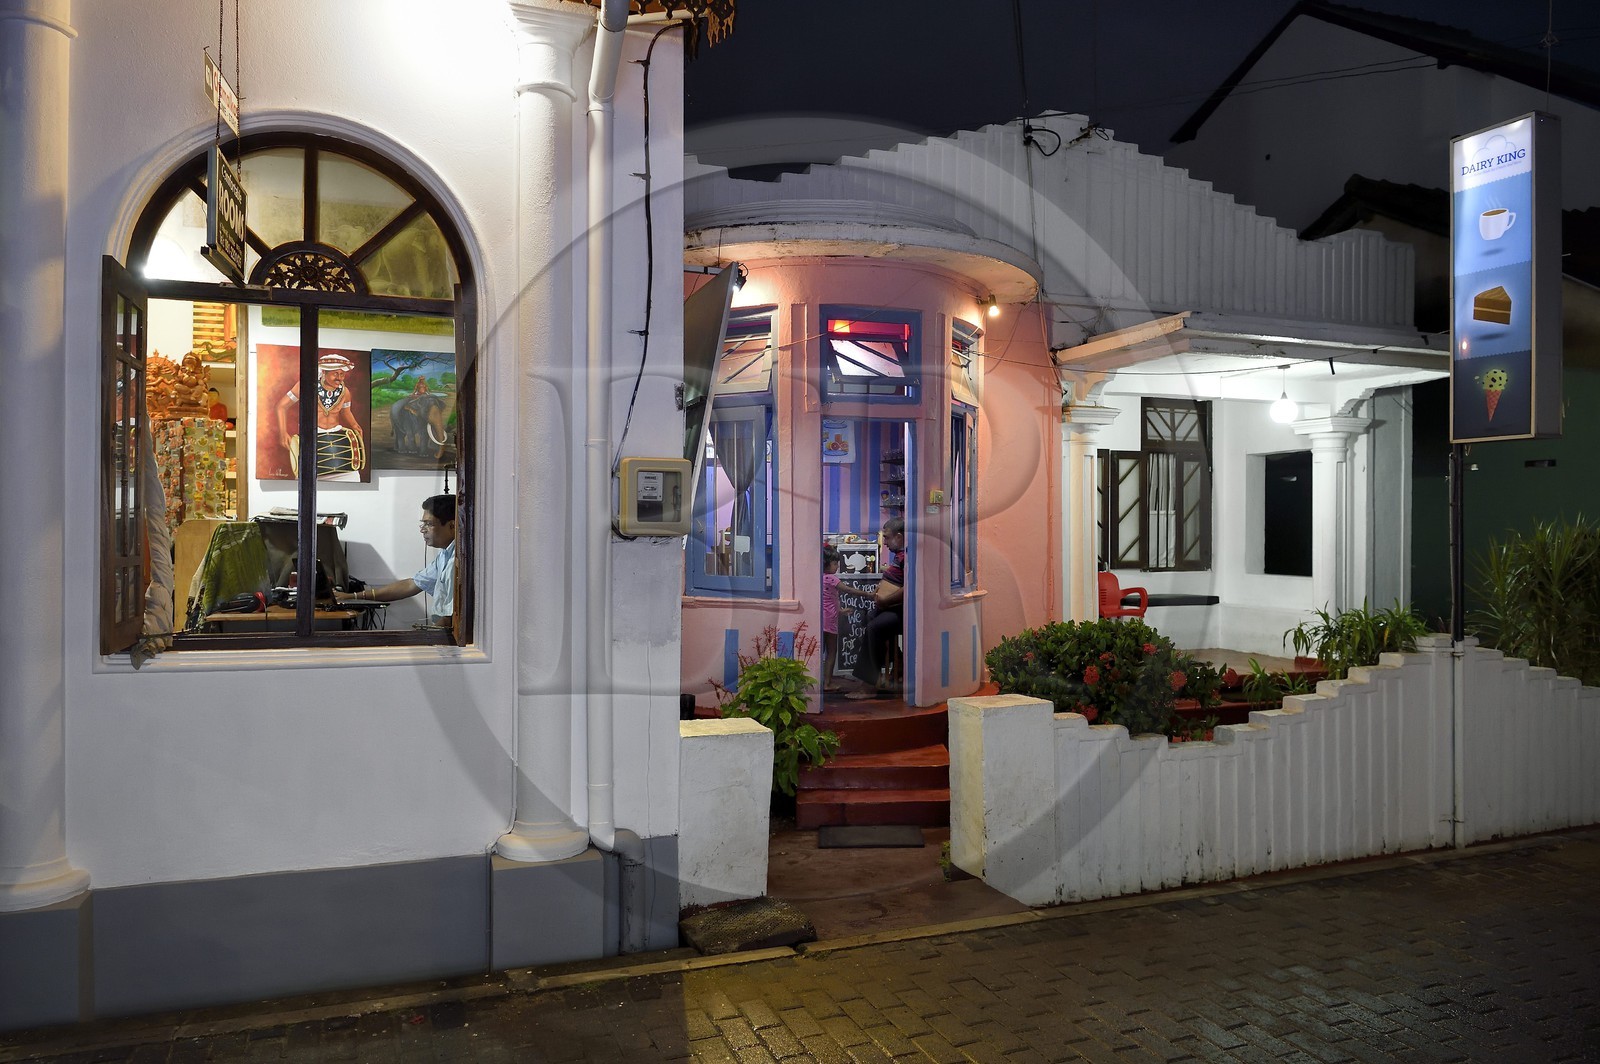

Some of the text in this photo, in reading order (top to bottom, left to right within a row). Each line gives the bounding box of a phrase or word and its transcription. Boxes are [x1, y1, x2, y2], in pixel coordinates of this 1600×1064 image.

[1461, 157, 1494, 176] DAIRY
[1496, 149, 1526, 166] KING
[219, 179, 244, 242] ROOMS
[852, 580, 878, 593] Screa
[840, 593, 858, 609] You
[848, 609, 862, 624] We
[841, 636, 857, 652] For
[841, 651, 858, 666] Ice
